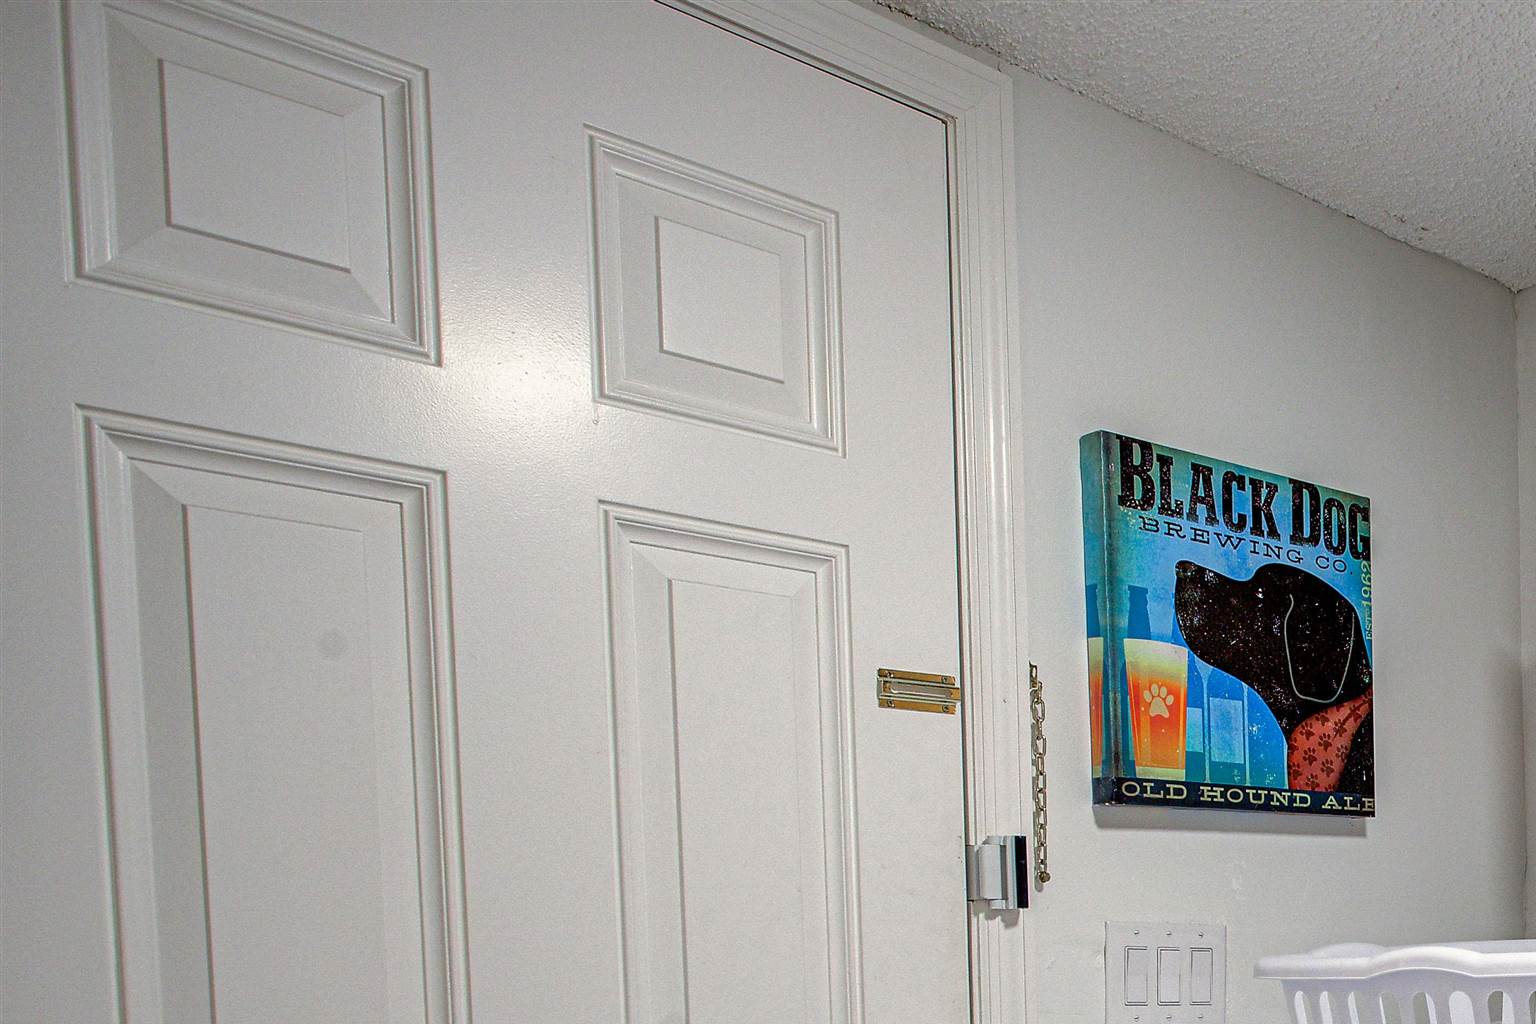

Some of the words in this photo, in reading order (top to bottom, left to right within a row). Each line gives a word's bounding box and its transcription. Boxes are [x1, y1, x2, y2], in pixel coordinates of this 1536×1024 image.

[1116, 434, 1279, 539] BLACK
[1289, 477, 1371, 561] DOG
[1139, 516, 1304, 565] BREWING
[1316, 556, 1353, 575] CO.
[1122, 780, 1187, 800] OLD
[1201, 786, 1312, 808] HOUND
[1322, 796, 1375, 812] ALE
